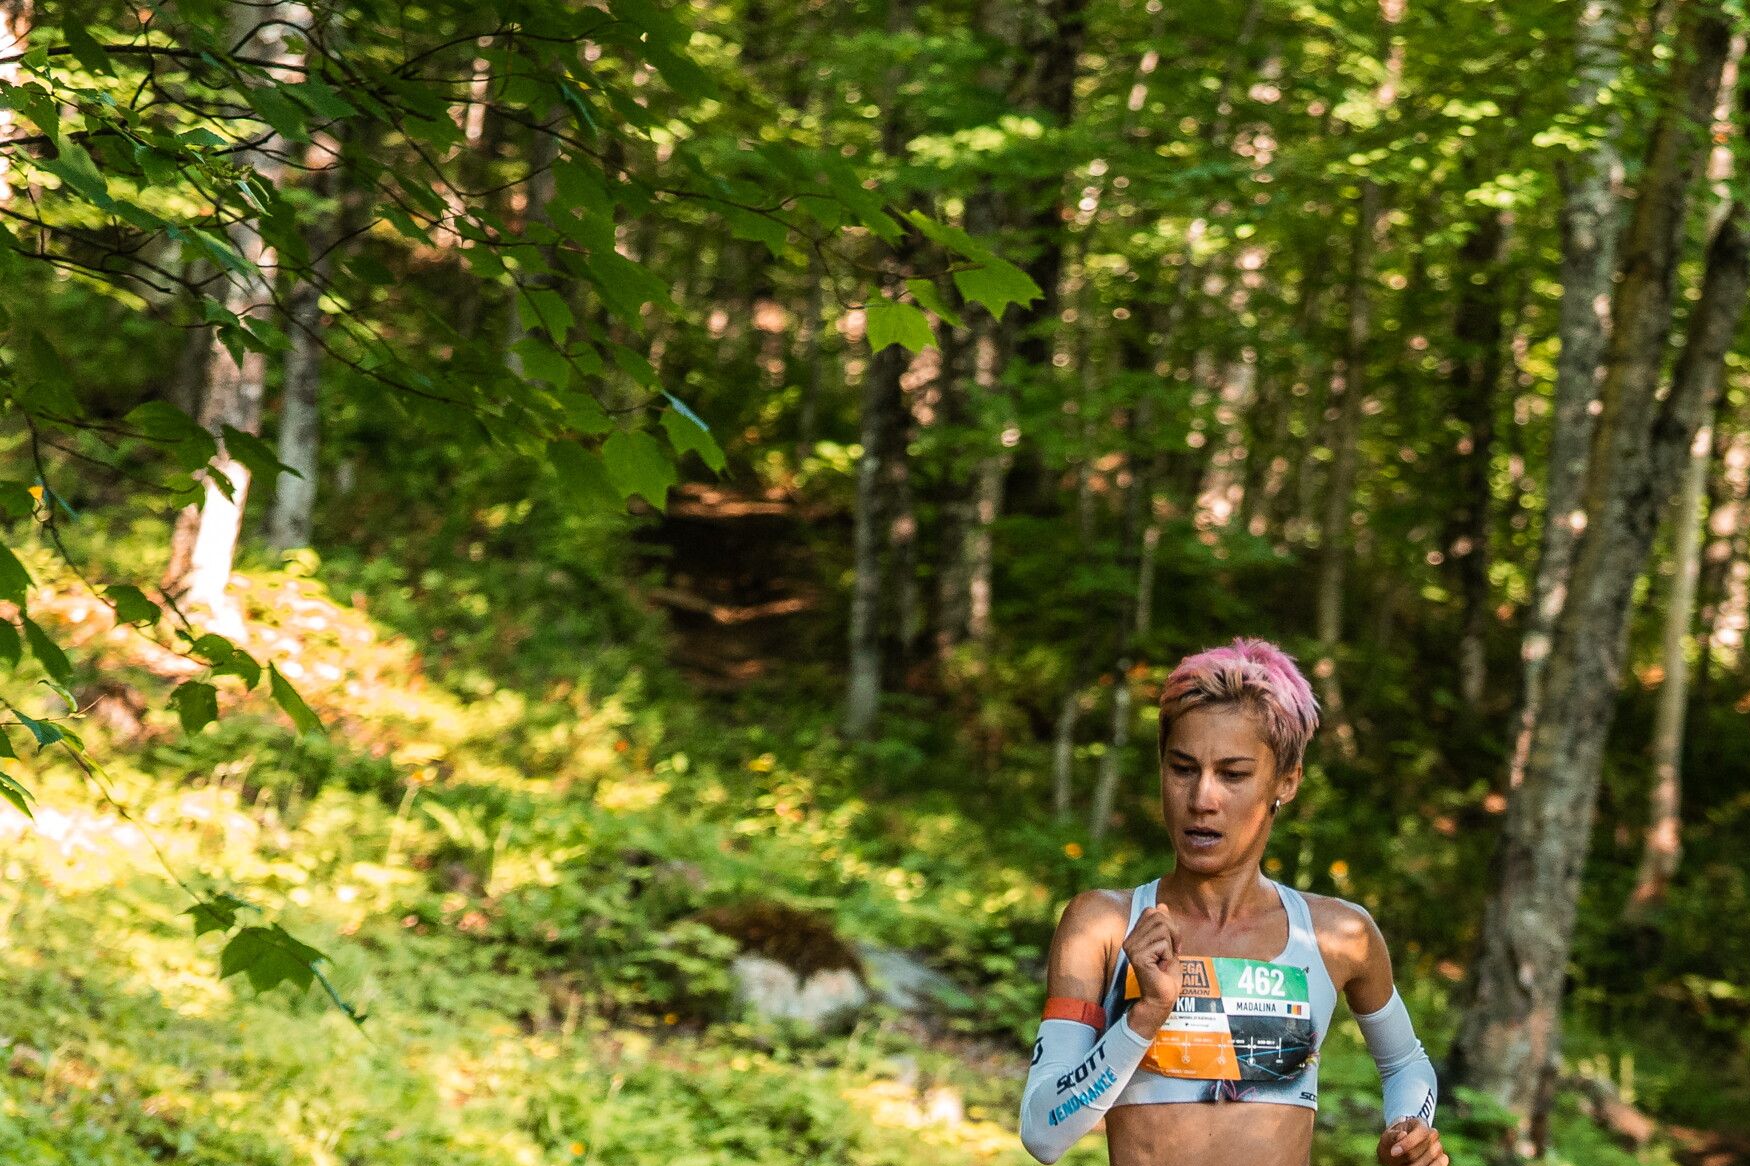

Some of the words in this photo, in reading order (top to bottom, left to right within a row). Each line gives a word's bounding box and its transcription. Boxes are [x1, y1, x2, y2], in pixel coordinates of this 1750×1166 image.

[1181, 961, 1203, 975] EGA
[1237, 965, 1286, 997] 462
[1180, 987, 1210, 996] OMON
[1176, 997, 1196, 1012] KM
[1235, 1001, 1277, 1013] MADALINA
[1056, 1040, 1106, 1096] SCOTT
